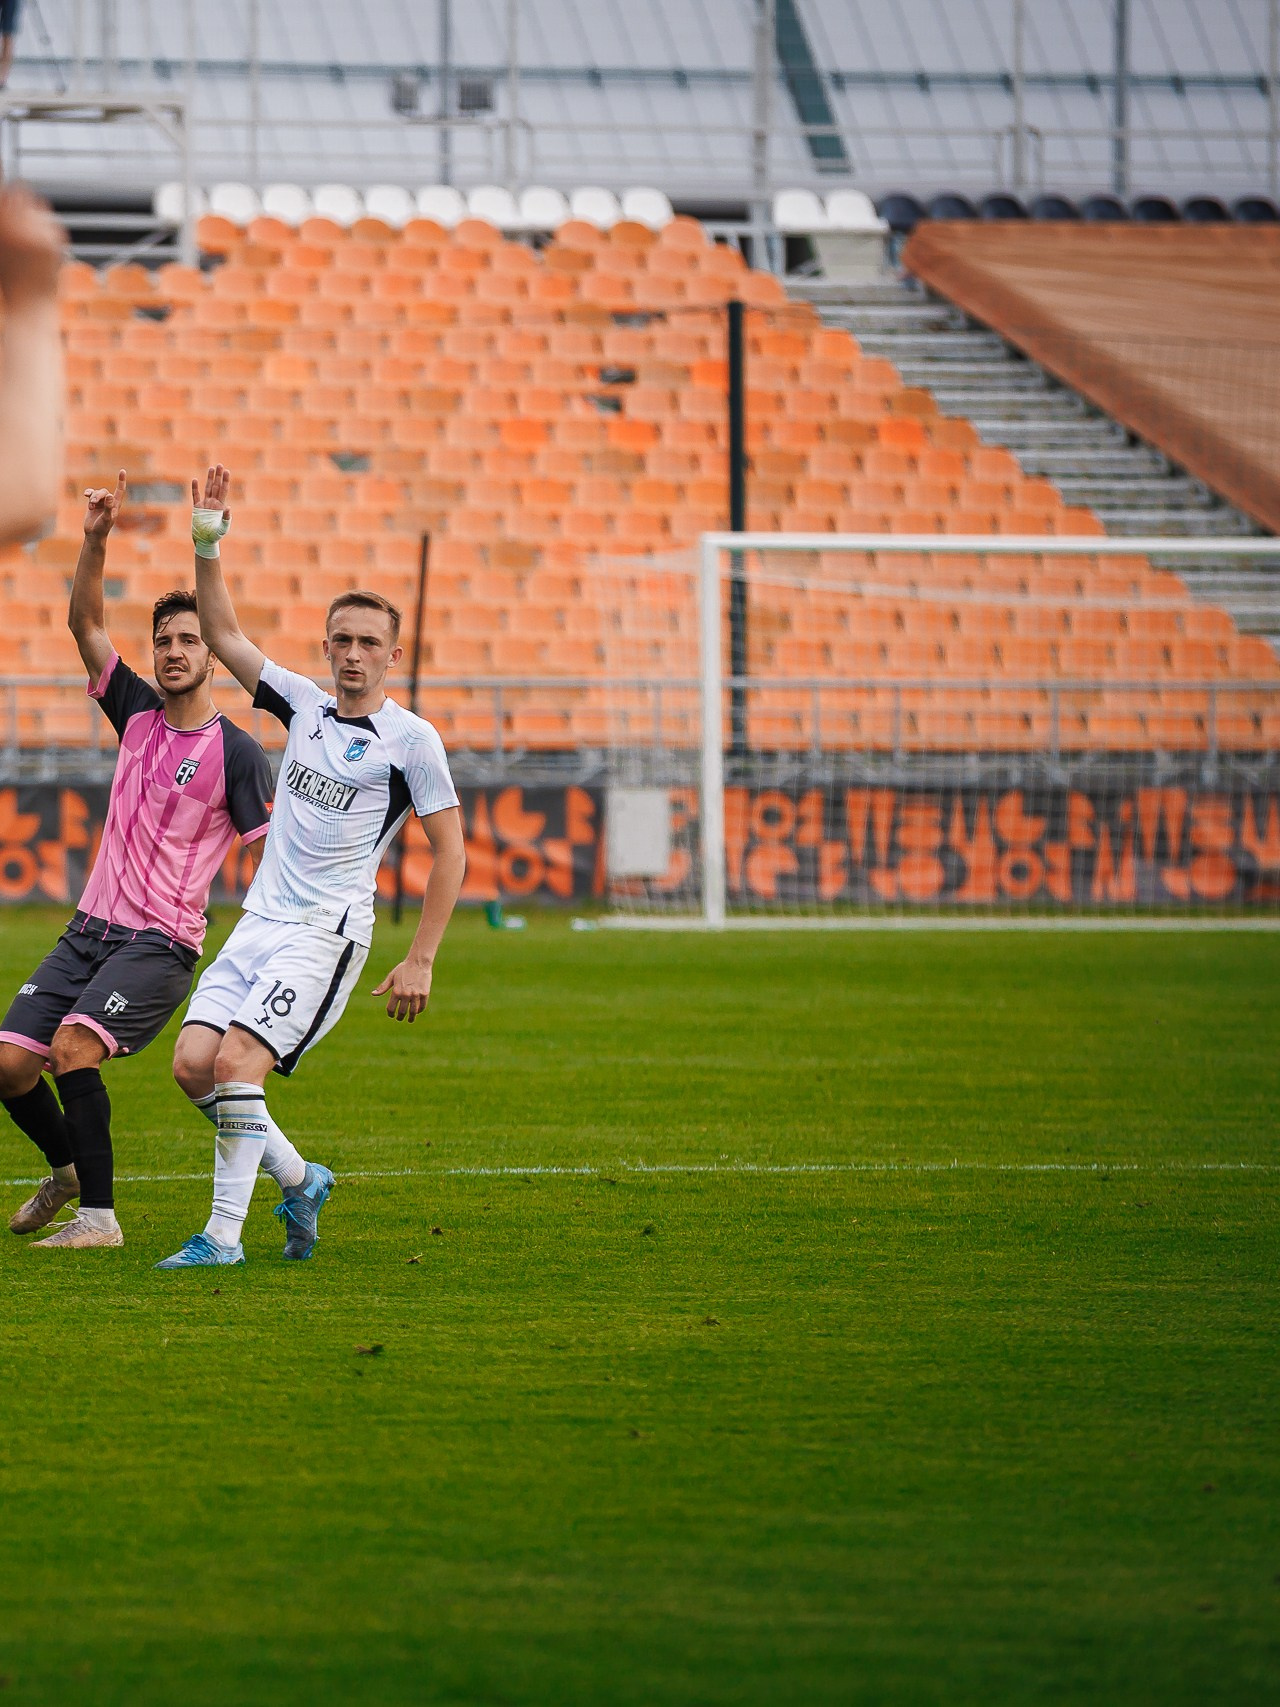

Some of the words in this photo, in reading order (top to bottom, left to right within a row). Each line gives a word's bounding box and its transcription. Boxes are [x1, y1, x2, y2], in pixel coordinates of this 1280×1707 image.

[175, 763, 197, 785] FC
[298, 769, 357, 810] ENERGY
[104, 995, 126, 1015] FC
[261, 980, 297, 1017] 18
[223, 1122, 267, 1132] ENERGY
